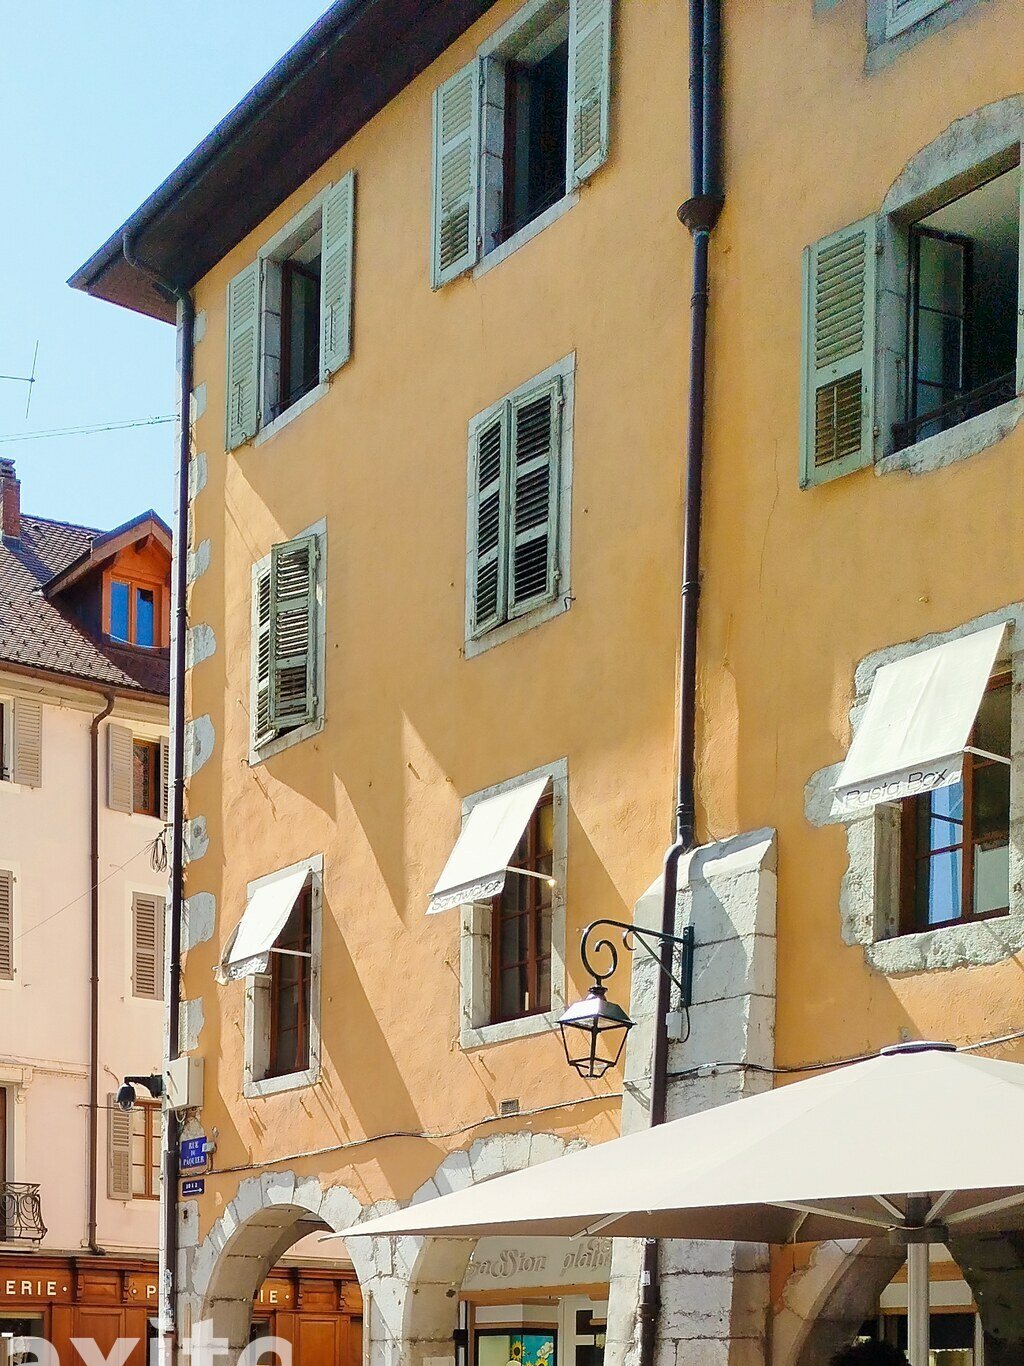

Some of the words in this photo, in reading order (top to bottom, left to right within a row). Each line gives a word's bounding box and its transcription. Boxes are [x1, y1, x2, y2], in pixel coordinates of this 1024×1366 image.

[845, 781, 901, 807] Pasta
[907, 768, 948, 791] Box
[189, 1141, 198, 1149] RUE
